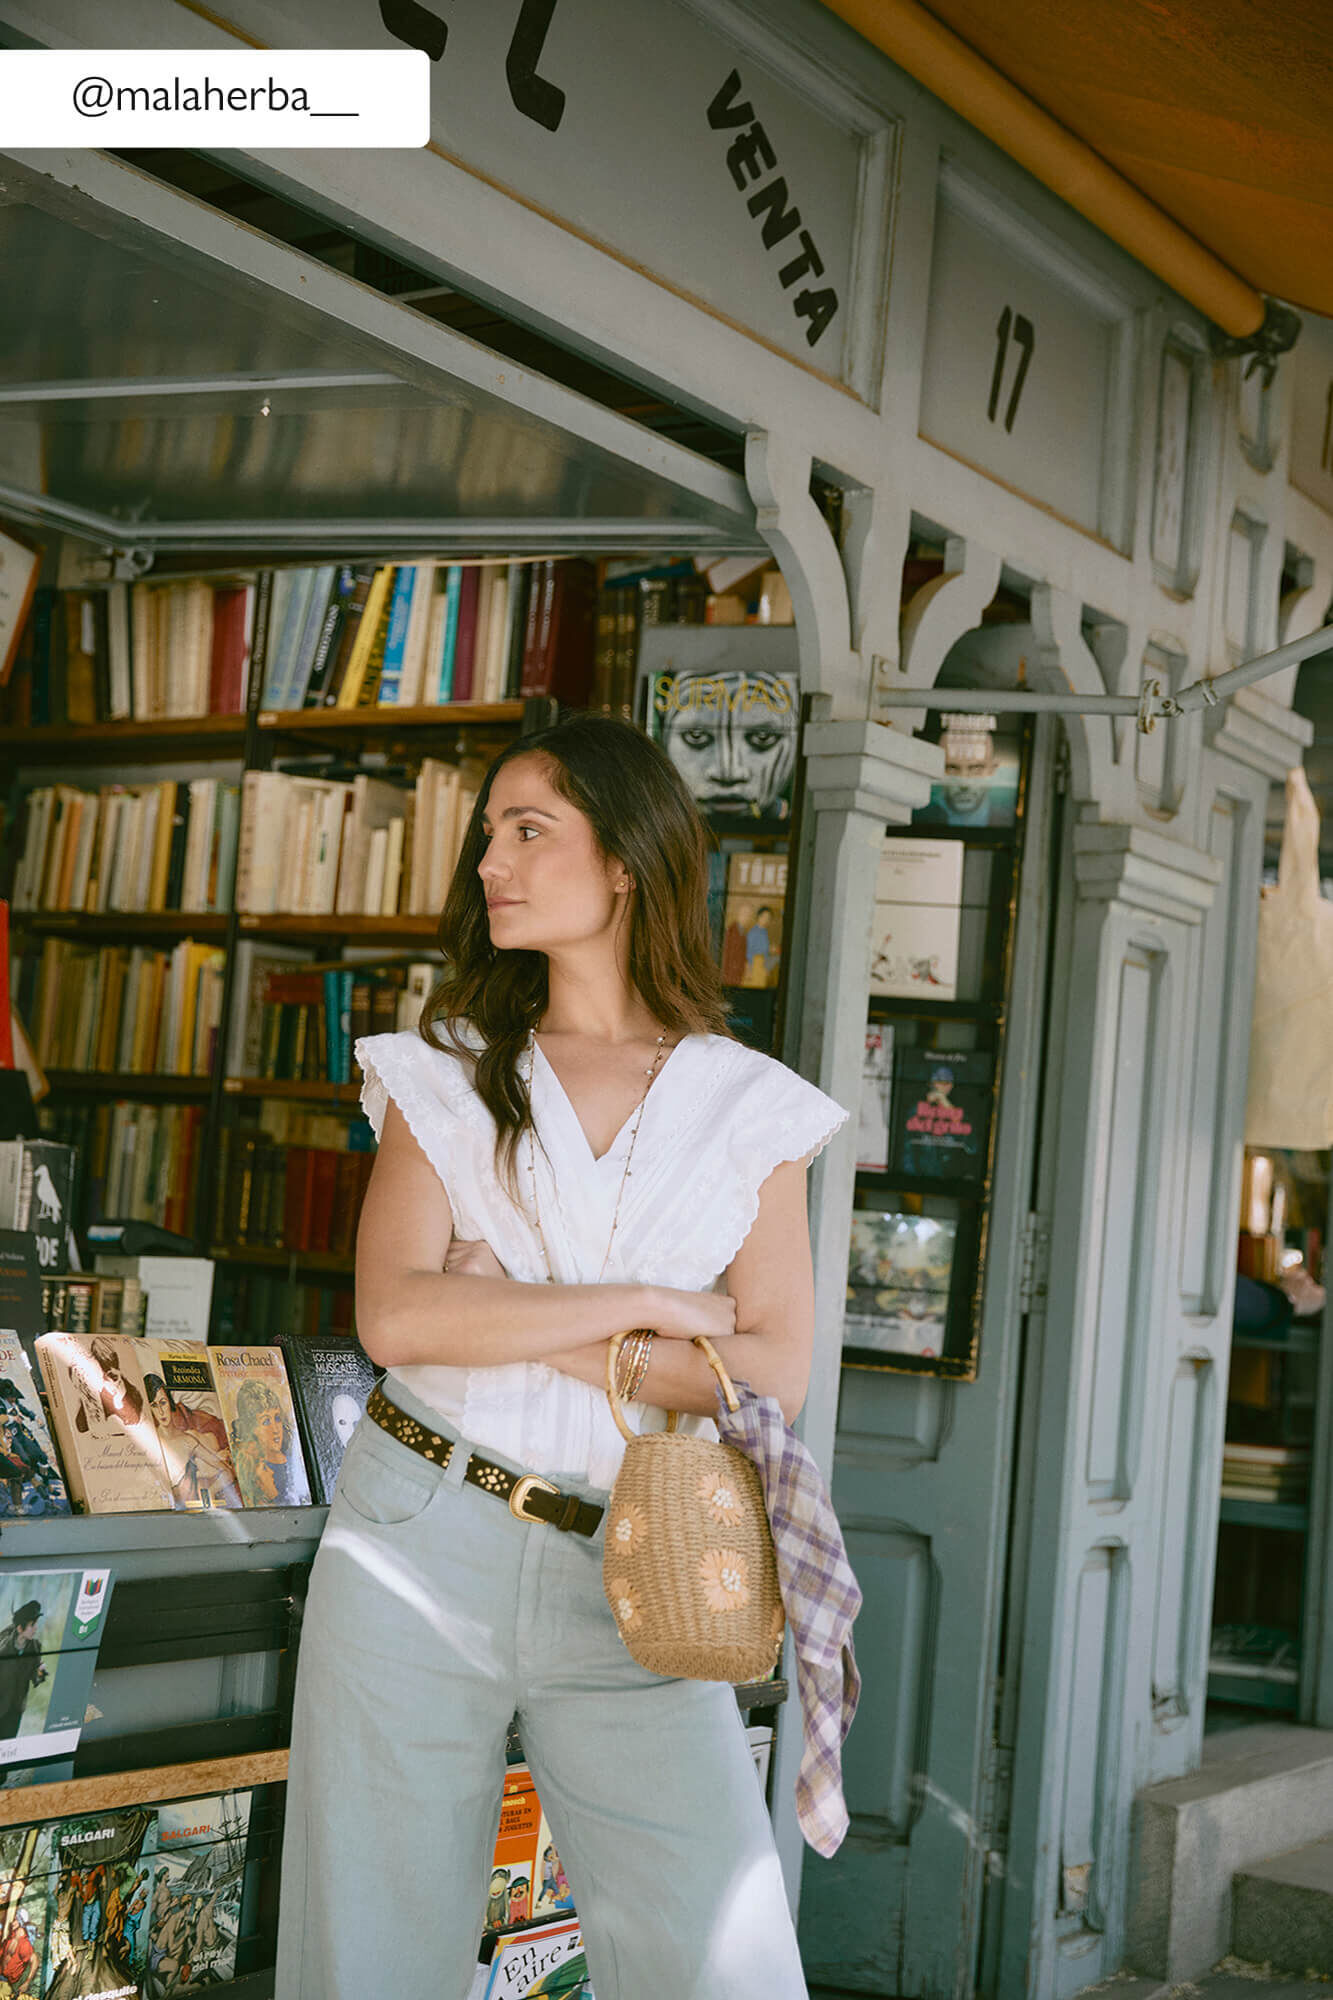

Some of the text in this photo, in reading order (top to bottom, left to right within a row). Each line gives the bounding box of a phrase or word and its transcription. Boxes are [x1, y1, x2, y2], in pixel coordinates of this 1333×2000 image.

[706, 68, 839, 347] VENTA
[987, 305, 1035, 435] 17
[655, 676, 791, 714] SURMAS
[215, 1352, 274, 1367] Rosa Chacel
[326, 1353, 358, 1363] GRANDES
[315, 1363, 359, 1375] MUSICALES
[61, 1828, 116, 1847] SALGARI
[161, 1825, 211, 1842] SALGARI
[204, 1949, 222, 1961] rey
[191, 1960, 209, 1972] del
[503, 1946, 536, 1984] En
[517, 1946, 561, 1994] aire
